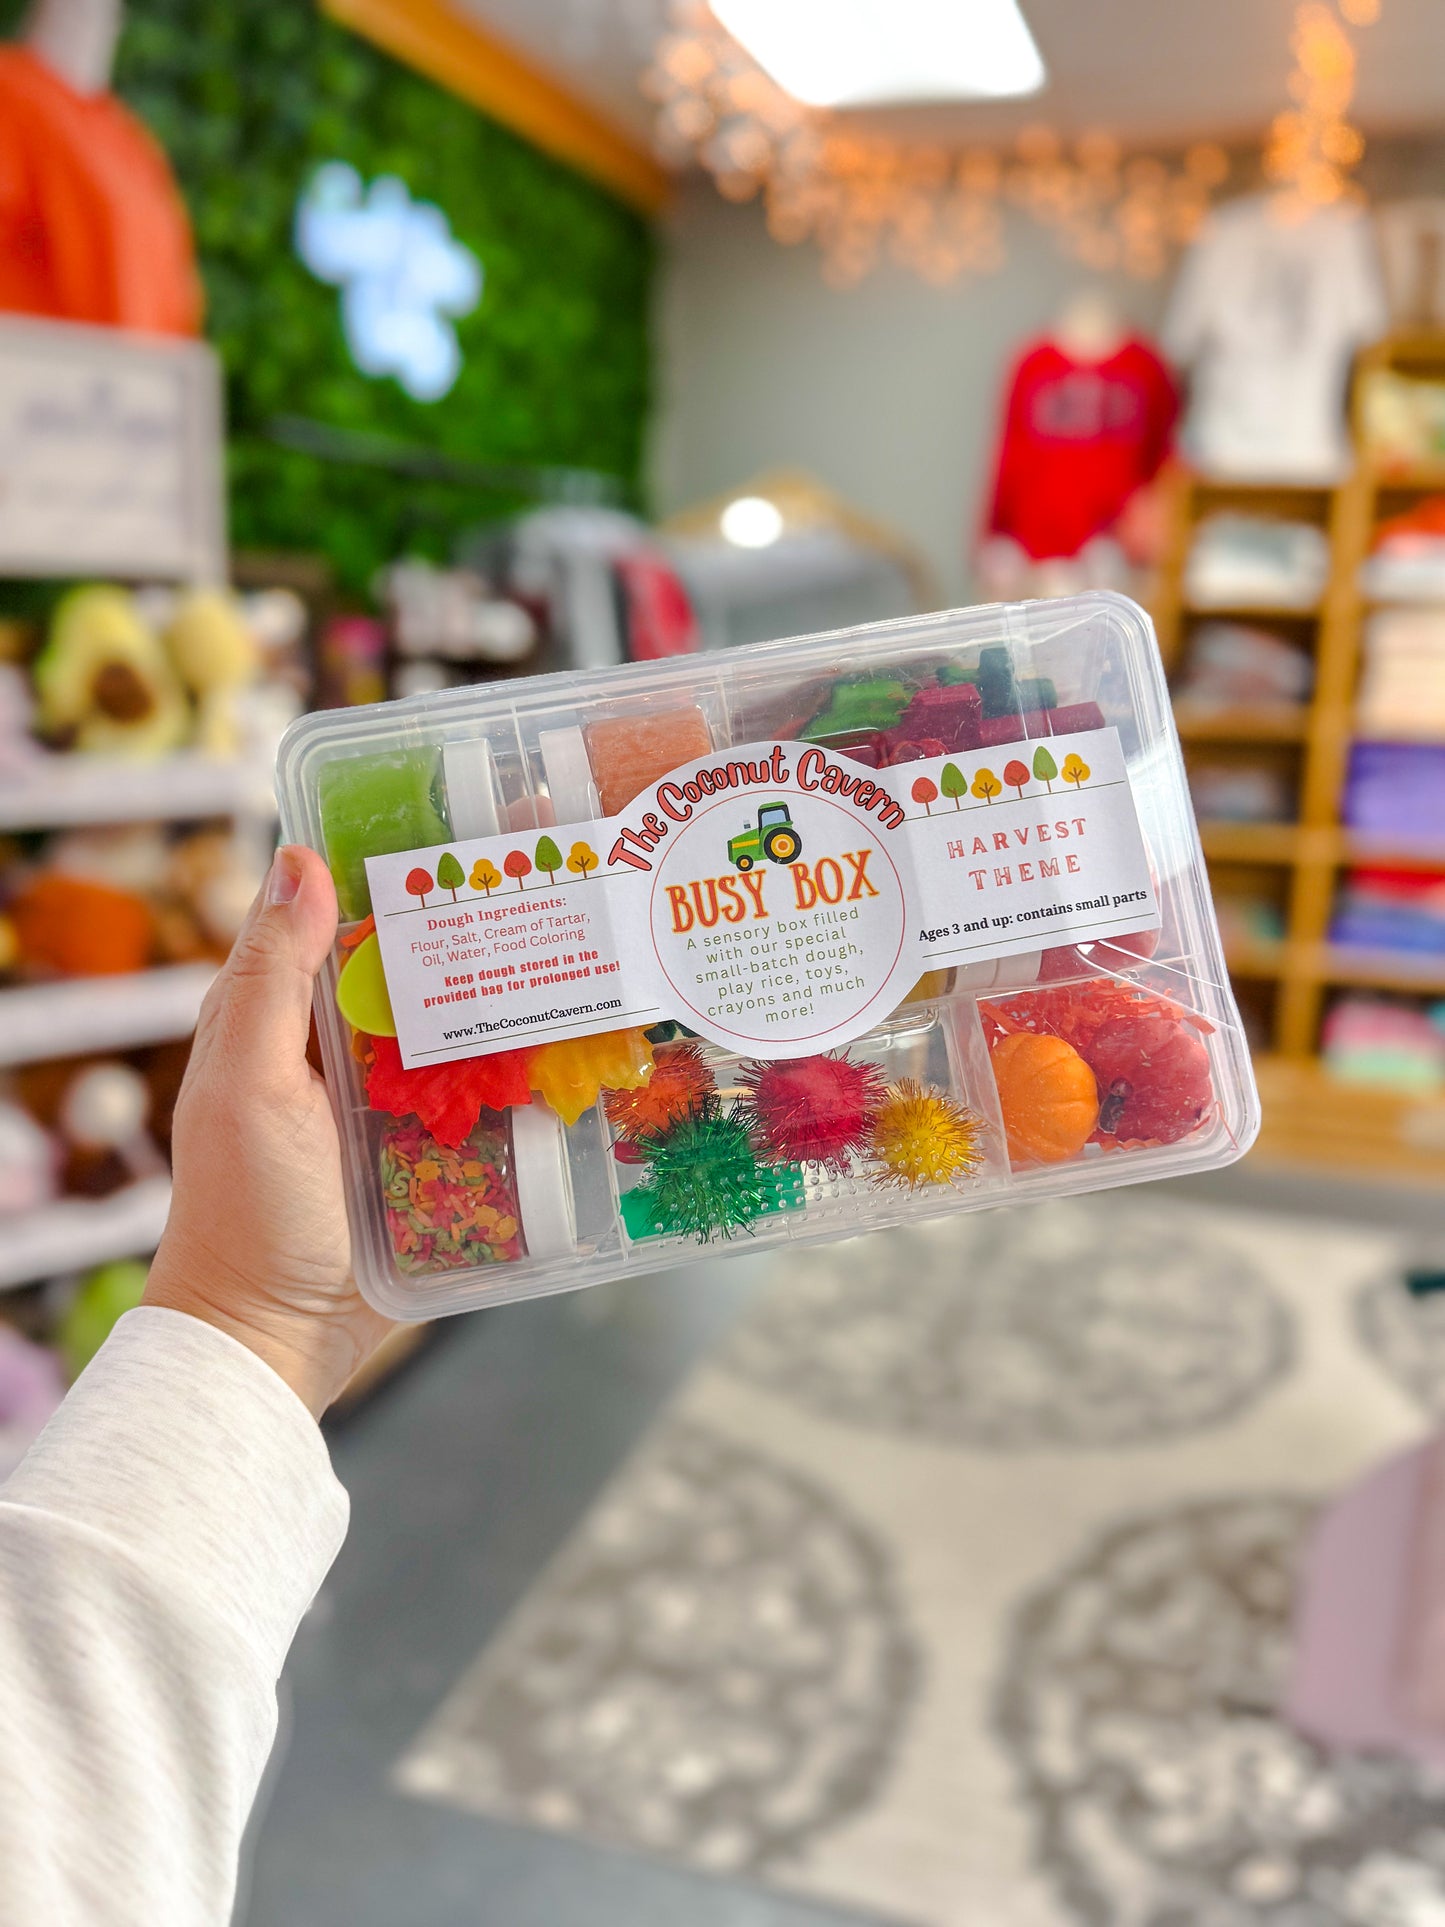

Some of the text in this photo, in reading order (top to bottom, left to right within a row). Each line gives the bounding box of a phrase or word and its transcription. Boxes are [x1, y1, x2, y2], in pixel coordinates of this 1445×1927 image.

[608, 746, 905, 871] The Coconut Cavern
[947, 818, 1086, 859] HARVEST
[665, 850, 880, 933] BUSY BOX
[968, 855, 1081, 890] THEME
[411, 913, 591, 953] Flour, Salt, Cream of Tartar,
[427, 897, 567, 931] Dough Ingredients:
[687, 907, 859, 950] A sensory box filled
[919, 890, 1147, 942] Ages 3 and up: contains small parts
[422, 928, 586, 968] Oil, Water, Food Coloring
[696, 943, 864, 984] small-batch dough,
[706, 927, 846, 964] with our special
[424, 961, 620, 1008] provided bag for prolonged use!
[445, 950, 599, 987] Keep dough stored in the
[717, 965, 849, 999] play rice, toys,
[707, 976, 865, 1017] crayons and much
[765, 1004, 815, 1023] more!
[443, 997, 622, 1040] www.TheCoconutCavern.com
